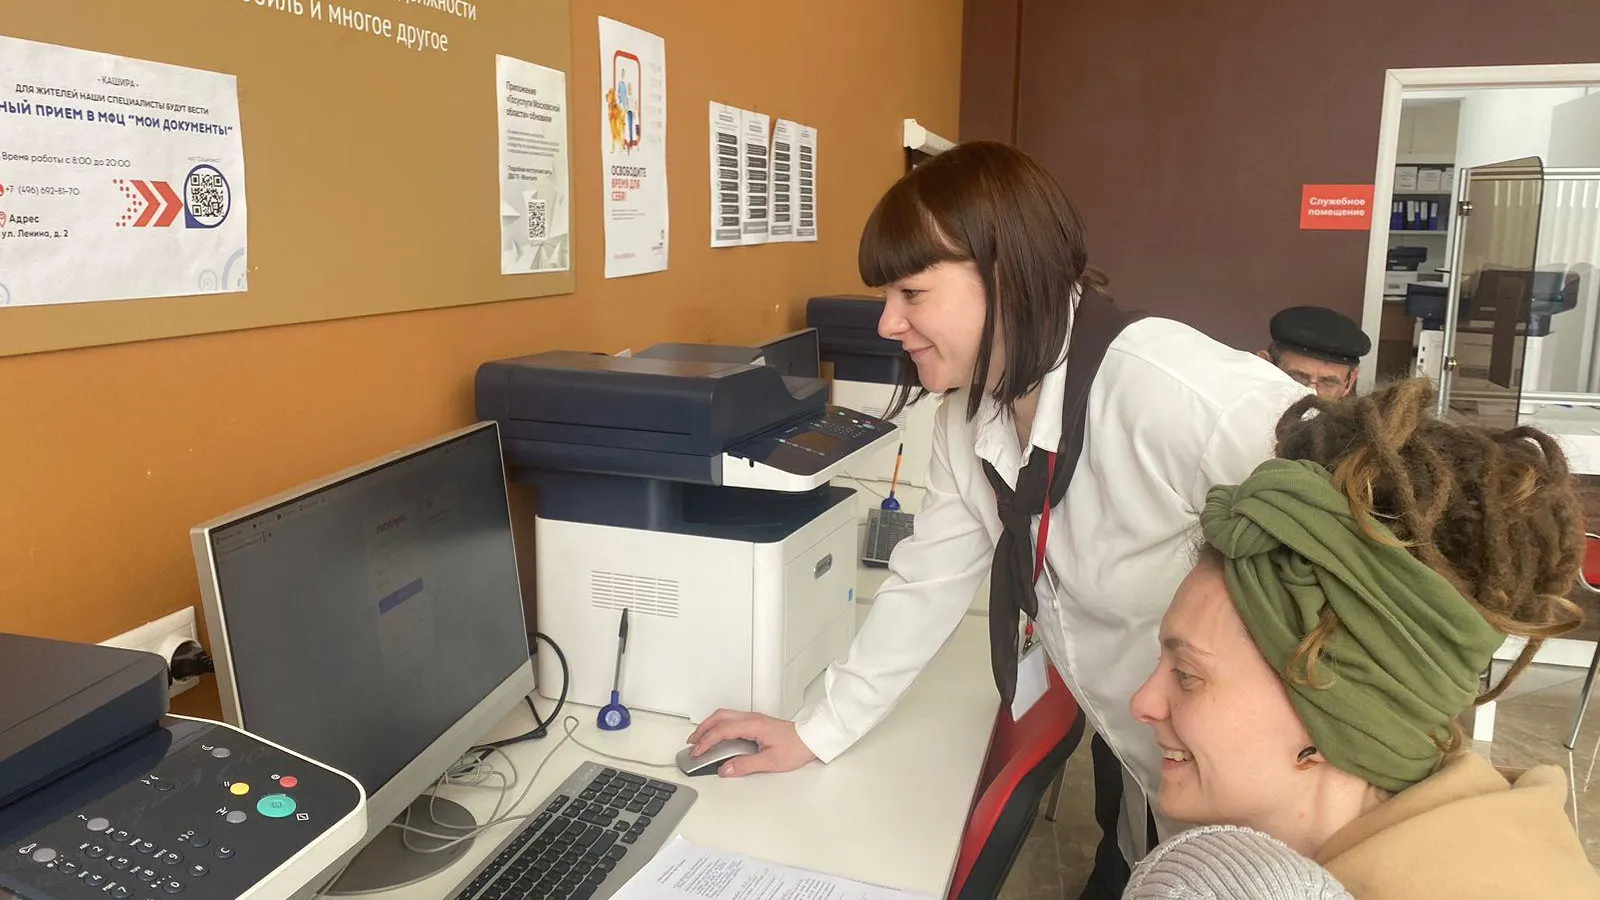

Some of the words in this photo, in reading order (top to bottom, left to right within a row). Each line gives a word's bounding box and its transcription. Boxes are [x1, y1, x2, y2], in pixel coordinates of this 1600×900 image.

[328, 5, 392, 37] многое
[396, 23, 448, 52] другое
[15, 83, 34, 94] ДЛЯ
[36, 86, 79, 99] ЖИТЕЛЕЙ
[80, 92, 105, 102] НАШИ
[107, 95, 165, 110] СПЕЦИАЛИСТЫ
[166, 102, 187, 113] БУДУТ
[188, 106, 209, 115] ВЕСТИ
[35, 104, 83, 120] ПРИЕМ
[86, 110, 95, 121] В
[98, 111, 126, 127] МФЦ
[1, 151, 29, 162] Время
[31, 154, 64, 165] работы
[94, 159, 104, 167] до
[18, 185, 39, 195] (496)
[1309, 197, 1366, 207] Служебное
[1308, 208, 1366, 217] помещение
[9, 214, 40, 225] Адрес
[1, 230, 16, 239] ул.
[63, 229, 69, 237] 2
